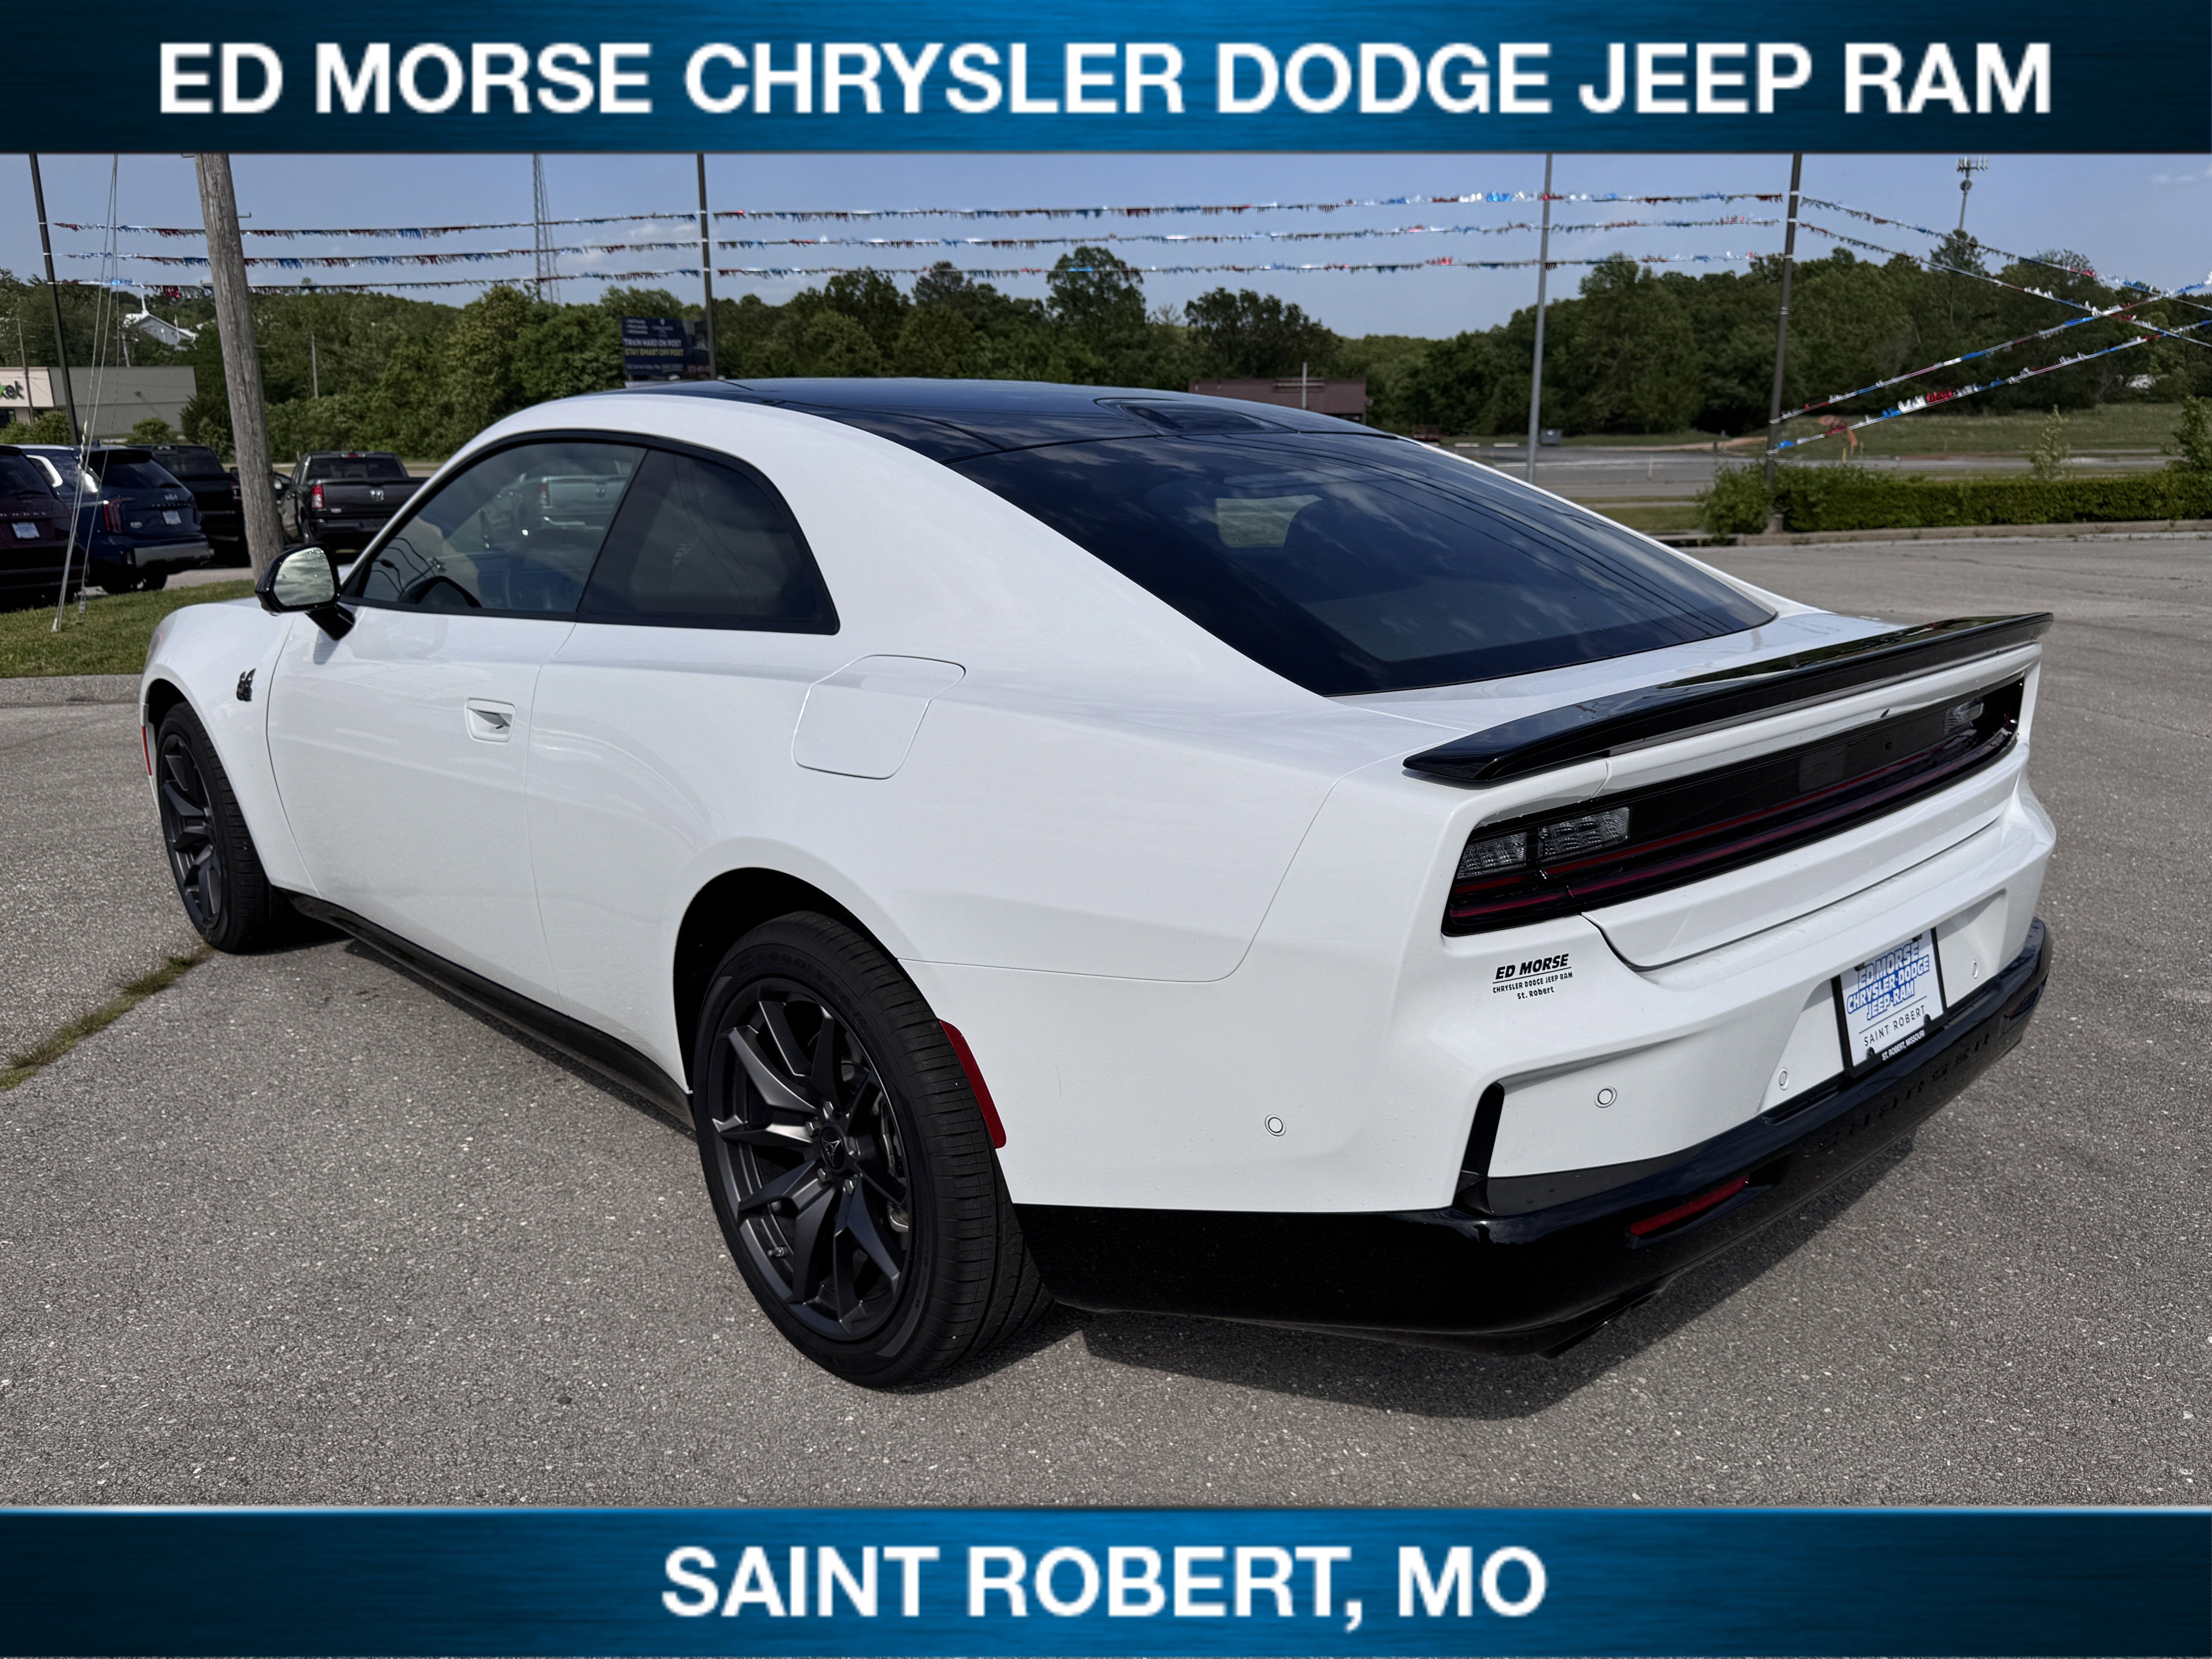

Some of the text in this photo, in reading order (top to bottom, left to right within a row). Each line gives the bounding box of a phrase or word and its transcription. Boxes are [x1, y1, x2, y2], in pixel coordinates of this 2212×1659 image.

[1495, 953, 1569, 980] ED MORSE
[1858, 941, 1919, 990] ED MORSE
[1492, 972, 1573, 993] CHRYSLER DODGE JEEP RAM
[1529, 986, 1554, 997] Robert
[1864, 1005, 1924, 1046] SAINT ROBERT
